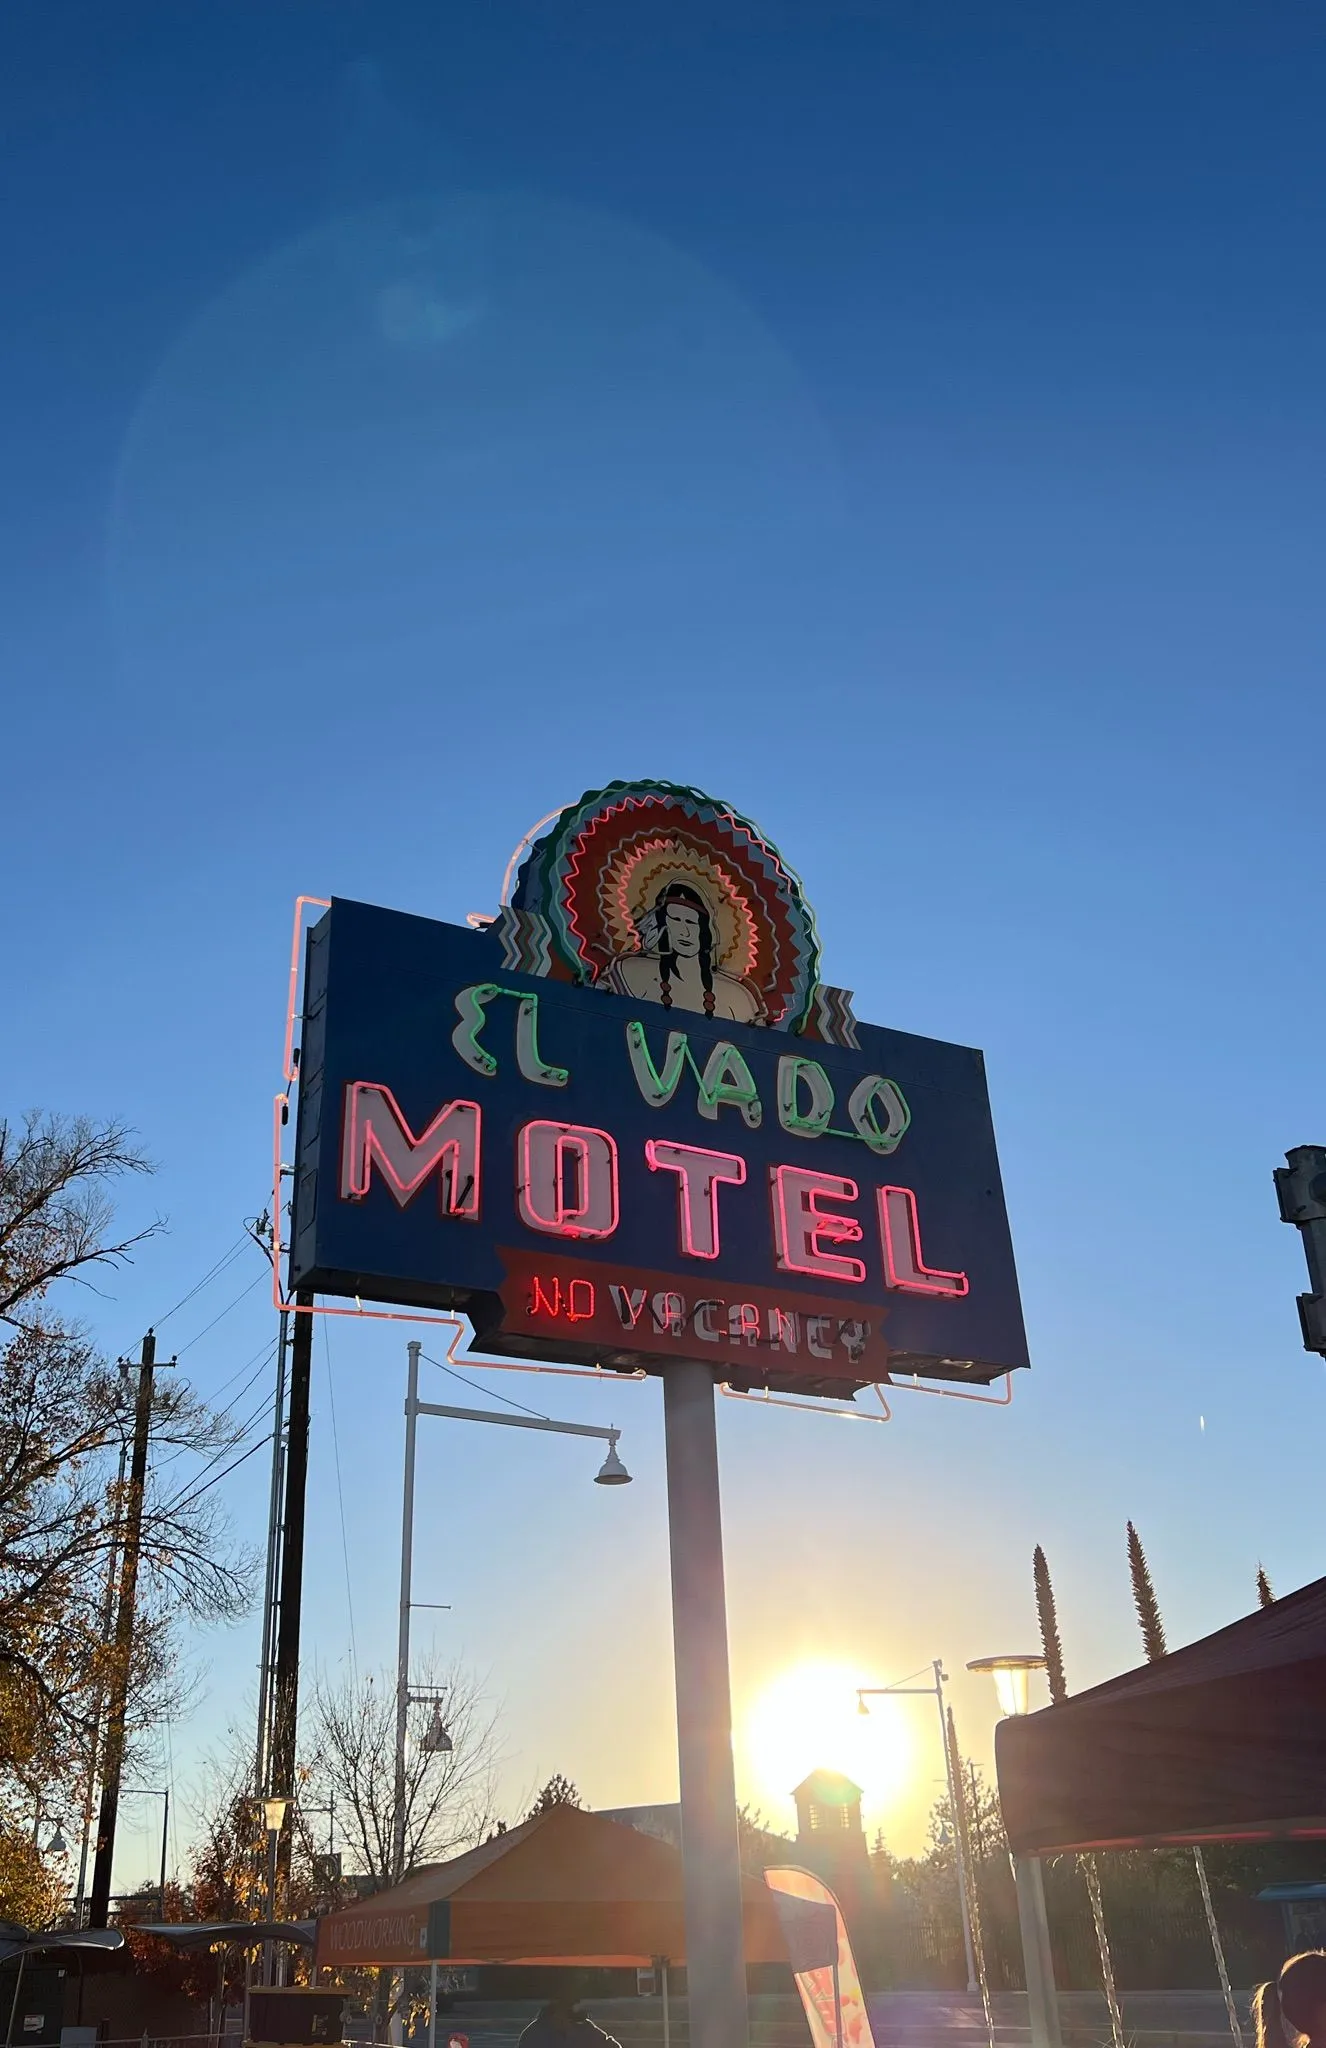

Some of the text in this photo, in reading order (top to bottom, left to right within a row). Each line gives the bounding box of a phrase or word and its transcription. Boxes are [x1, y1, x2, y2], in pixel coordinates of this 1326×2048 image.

[452, 983, 912, 1155] EL VADO
[340, 1081, 970, 1297] MOTEL
[529, 1276, 872, 1364] NO VACANCY
[329, 1914, 416, 1954] WOODWORKING
